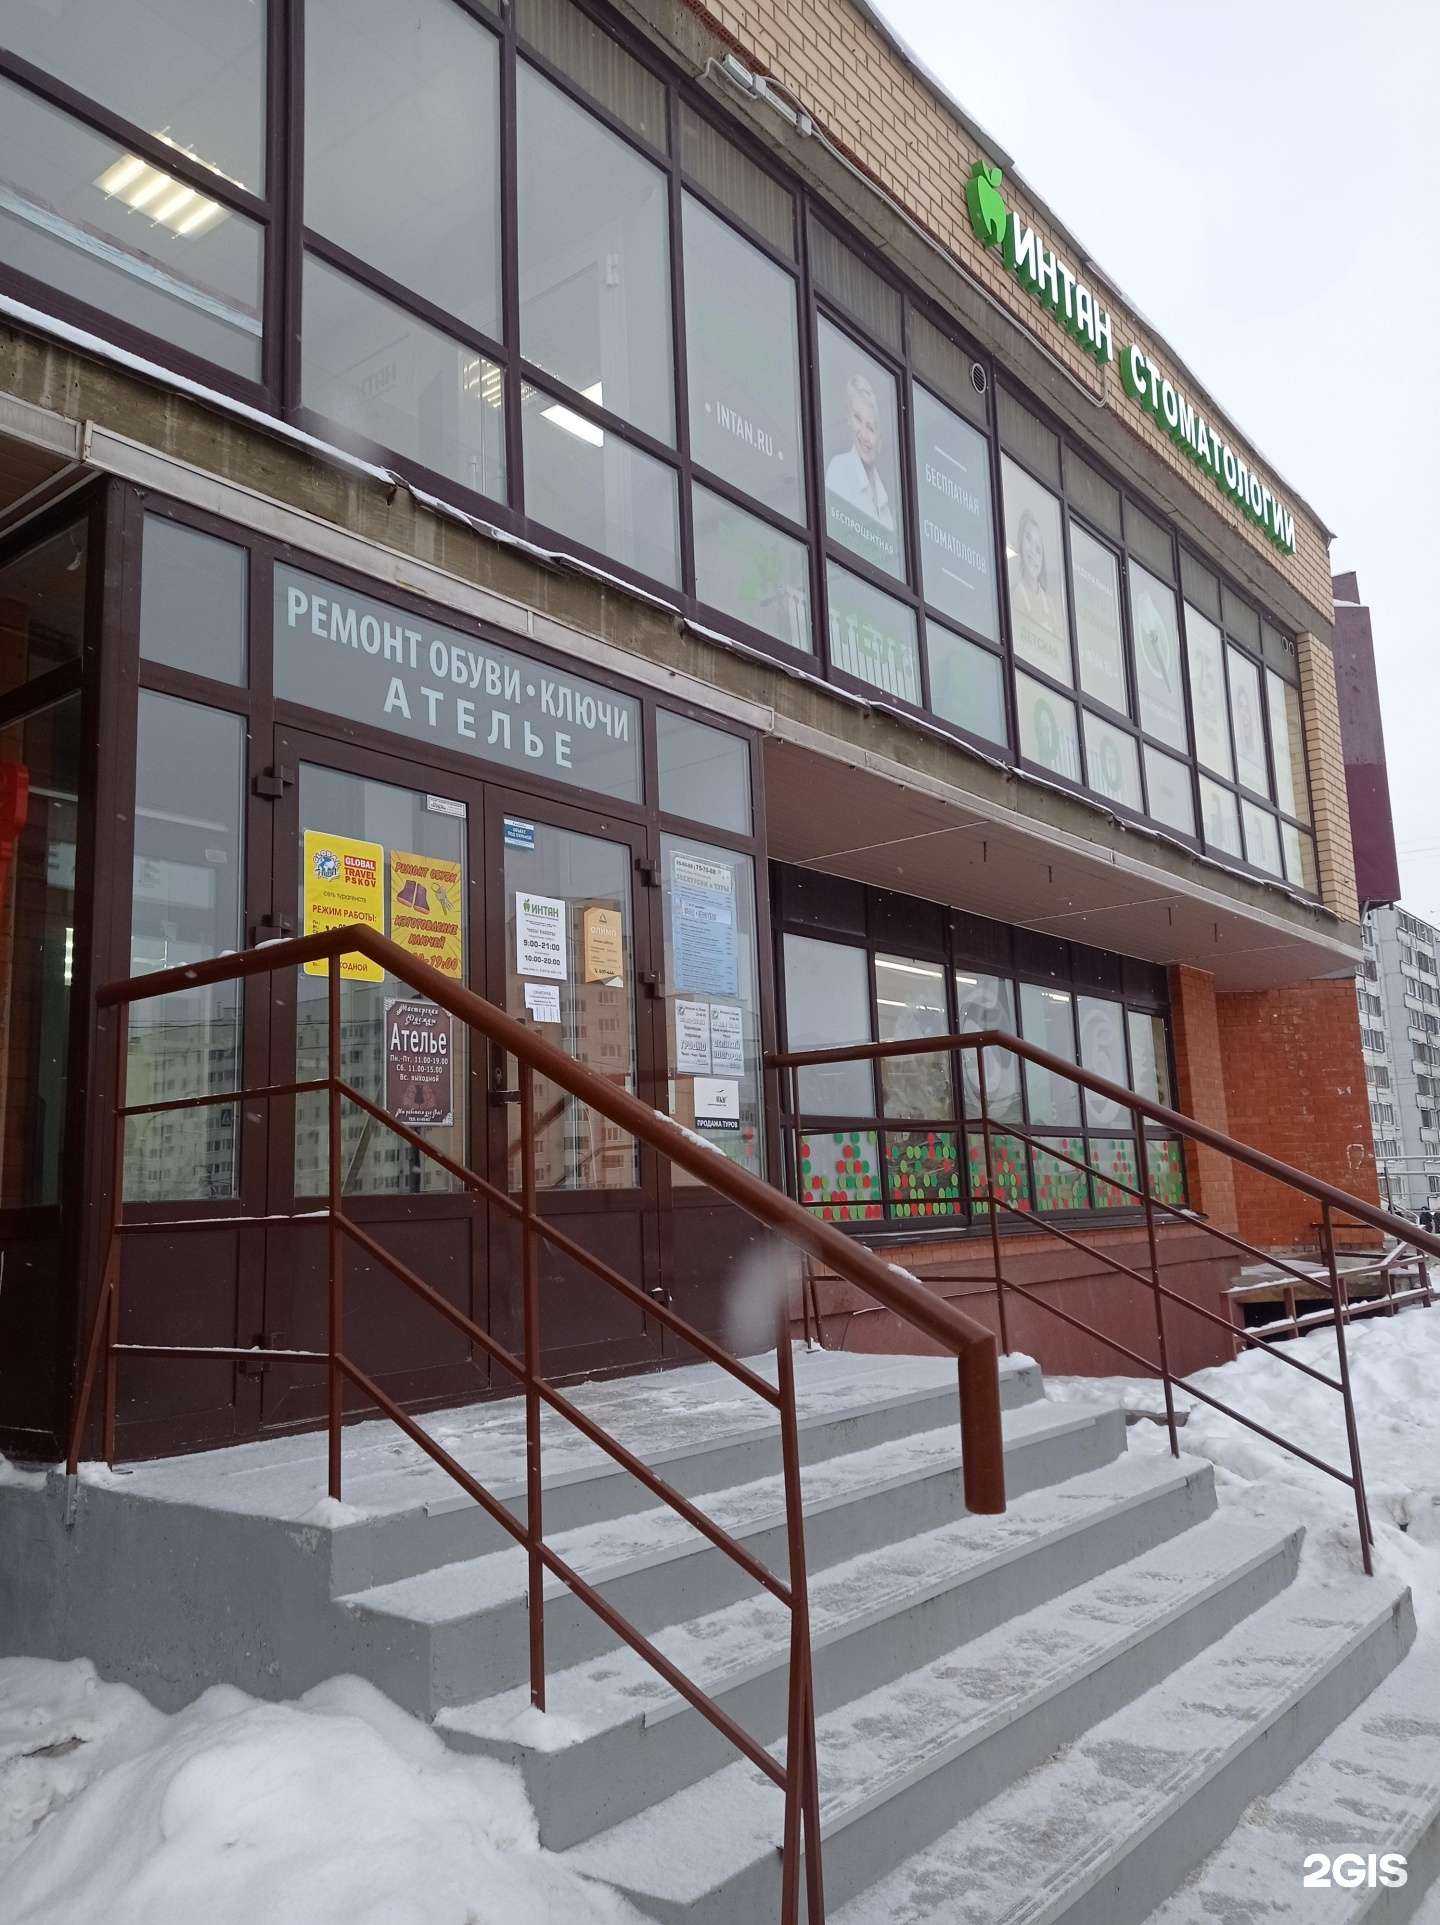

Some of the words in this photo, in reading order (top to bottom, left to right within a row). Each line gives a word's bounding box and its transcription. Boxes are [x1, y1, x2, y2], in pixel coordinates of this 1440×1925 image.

[1008, 211, 1113, 363] ИНТАН
[1125, 344, 1297, 554] СТОМАТОЛОГИИ
[716, 400, 774, 457] INTAN.RU
[925, 463, 980, 517] БЕСПЛАТНАЯ
[286, 585, 423, 669] РЕМОНТ
[429, 639, 521, 705] ОБУВИ
[540, 678, 630, 743] КЛЮЧИ
[383, 676, 574, 769] АТЕЛЬЕ
[345, 856, 375, 869] GLOBAL
[345, 868, 376, 880] TRAVEL
[345, 876, 376, 888] PSKOV
[312, 904, 341, 916] РЕЖИМ
[343, 909, 377, 922] РАБОТЫ:
[531, 903, 560, 918] ИНТАН
[390, 1022, 448, 1055] Ателье
[696, 1119, 722, 1129] ПРОДАЖА
[722, 1120, 738, 1129] ТУРОВ
